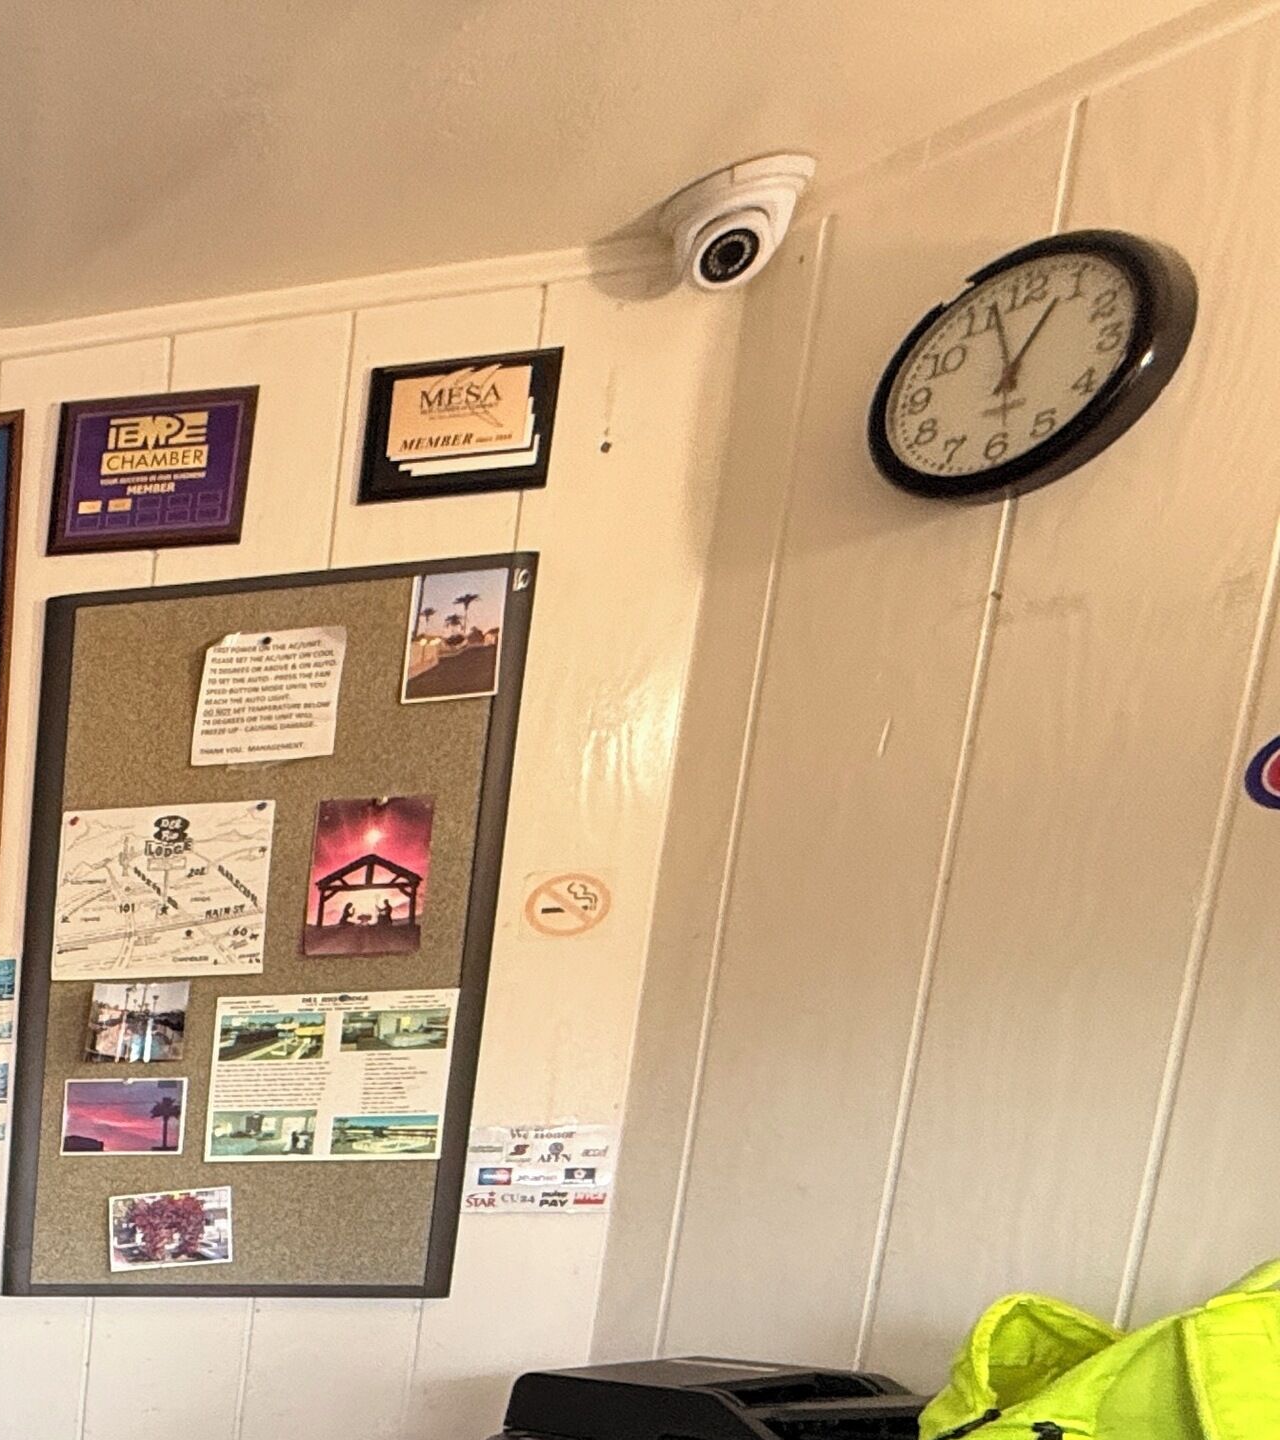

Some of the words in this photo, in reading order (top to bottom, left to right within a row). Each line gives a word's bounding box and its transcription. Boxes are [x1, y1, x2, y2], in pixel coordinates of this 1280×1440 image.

[1008, 274, 1050, 313] 12
[1067, 263, 1088, 300] 1
[1092, 290, 1117, 322] 2
[1096, 321, 1124, 352] 3
[925, 345, 967, 381] 10
[420, 381, 503, 409] MESA
[1071, 366, 1096, 397] 4
[909, 387, 932, 416] 9
[107, 411, 209, 450] TEMPE
[913, 418, 938, 446] 8
[1029, 408, 1056, 438] 5
[398, 432, 474, 452] MEMBER
[943, 436, 968, 463] 7
[982, 432, 1008, 461] 6
[106, 449, 204, 471] CHAMBER
[126, 482, 176, 495] MEMBER
[145, 838, 193, 857] LODGE
[119, 903, 136, 913] 101
[205, 907, 231, 919] MAIN
[233, 904, 245, 913] ST
[232, 926, 248, 936] 60
[465, 1197, 496, 1208] STAR
